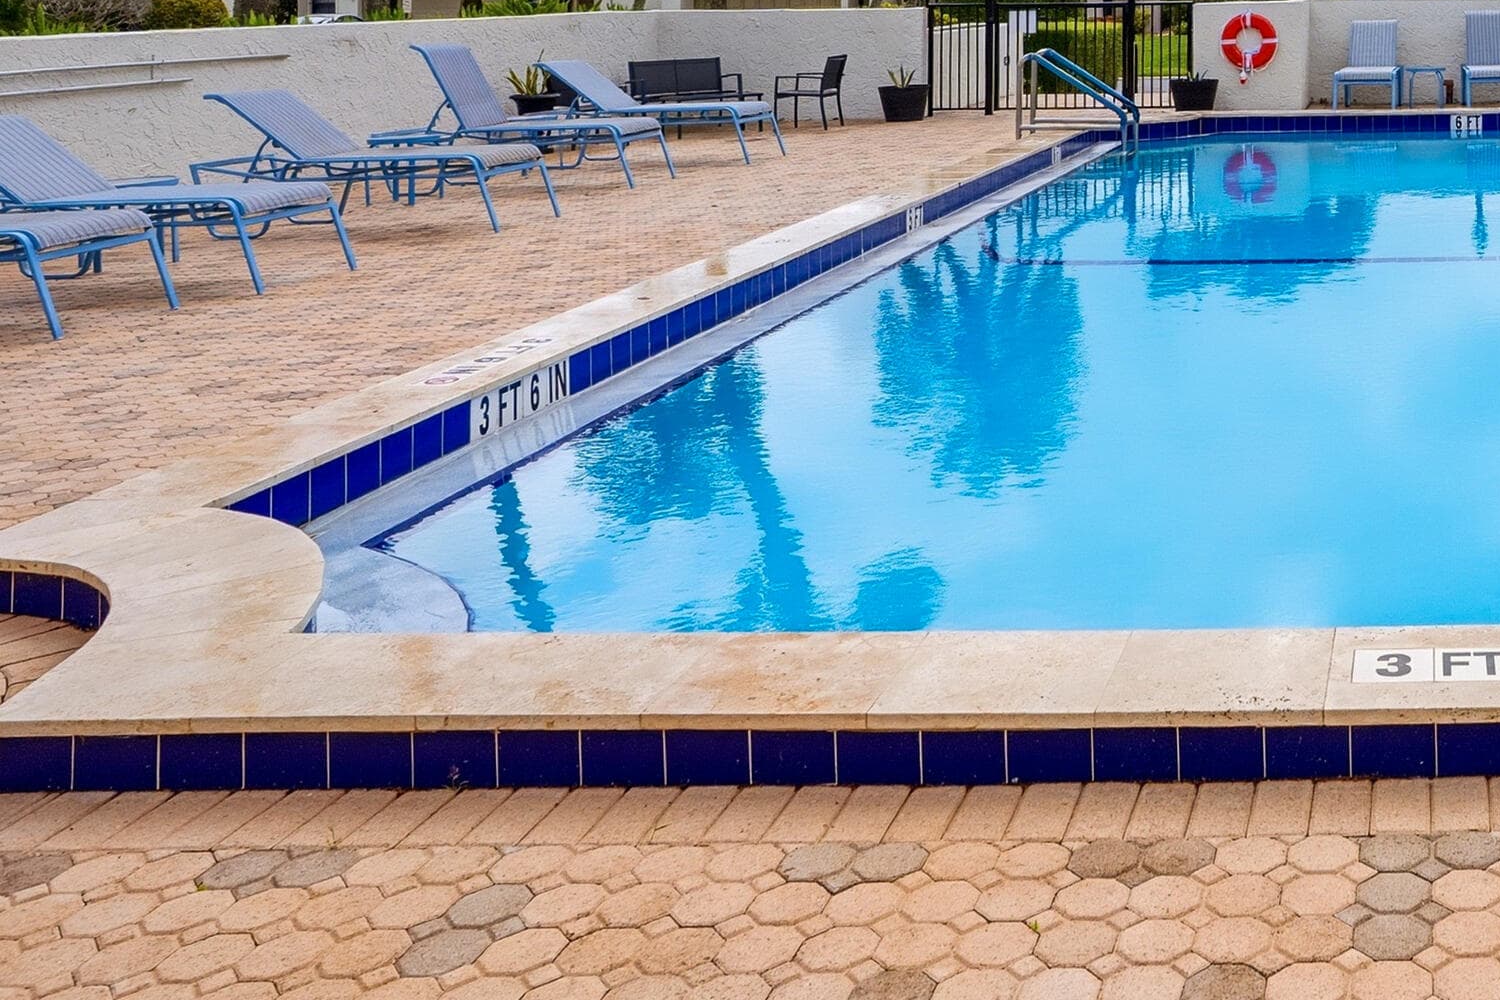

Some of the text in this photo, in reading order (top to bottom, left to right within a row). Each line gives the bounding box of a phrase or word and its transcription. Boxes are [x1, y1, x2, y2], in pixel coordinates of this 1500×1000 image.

[1456, 115, 1480, 129] 6 FT
[479, 360, 567, 436] 3 FT 6 IN
[1375, 653, 1412, 677] 3
